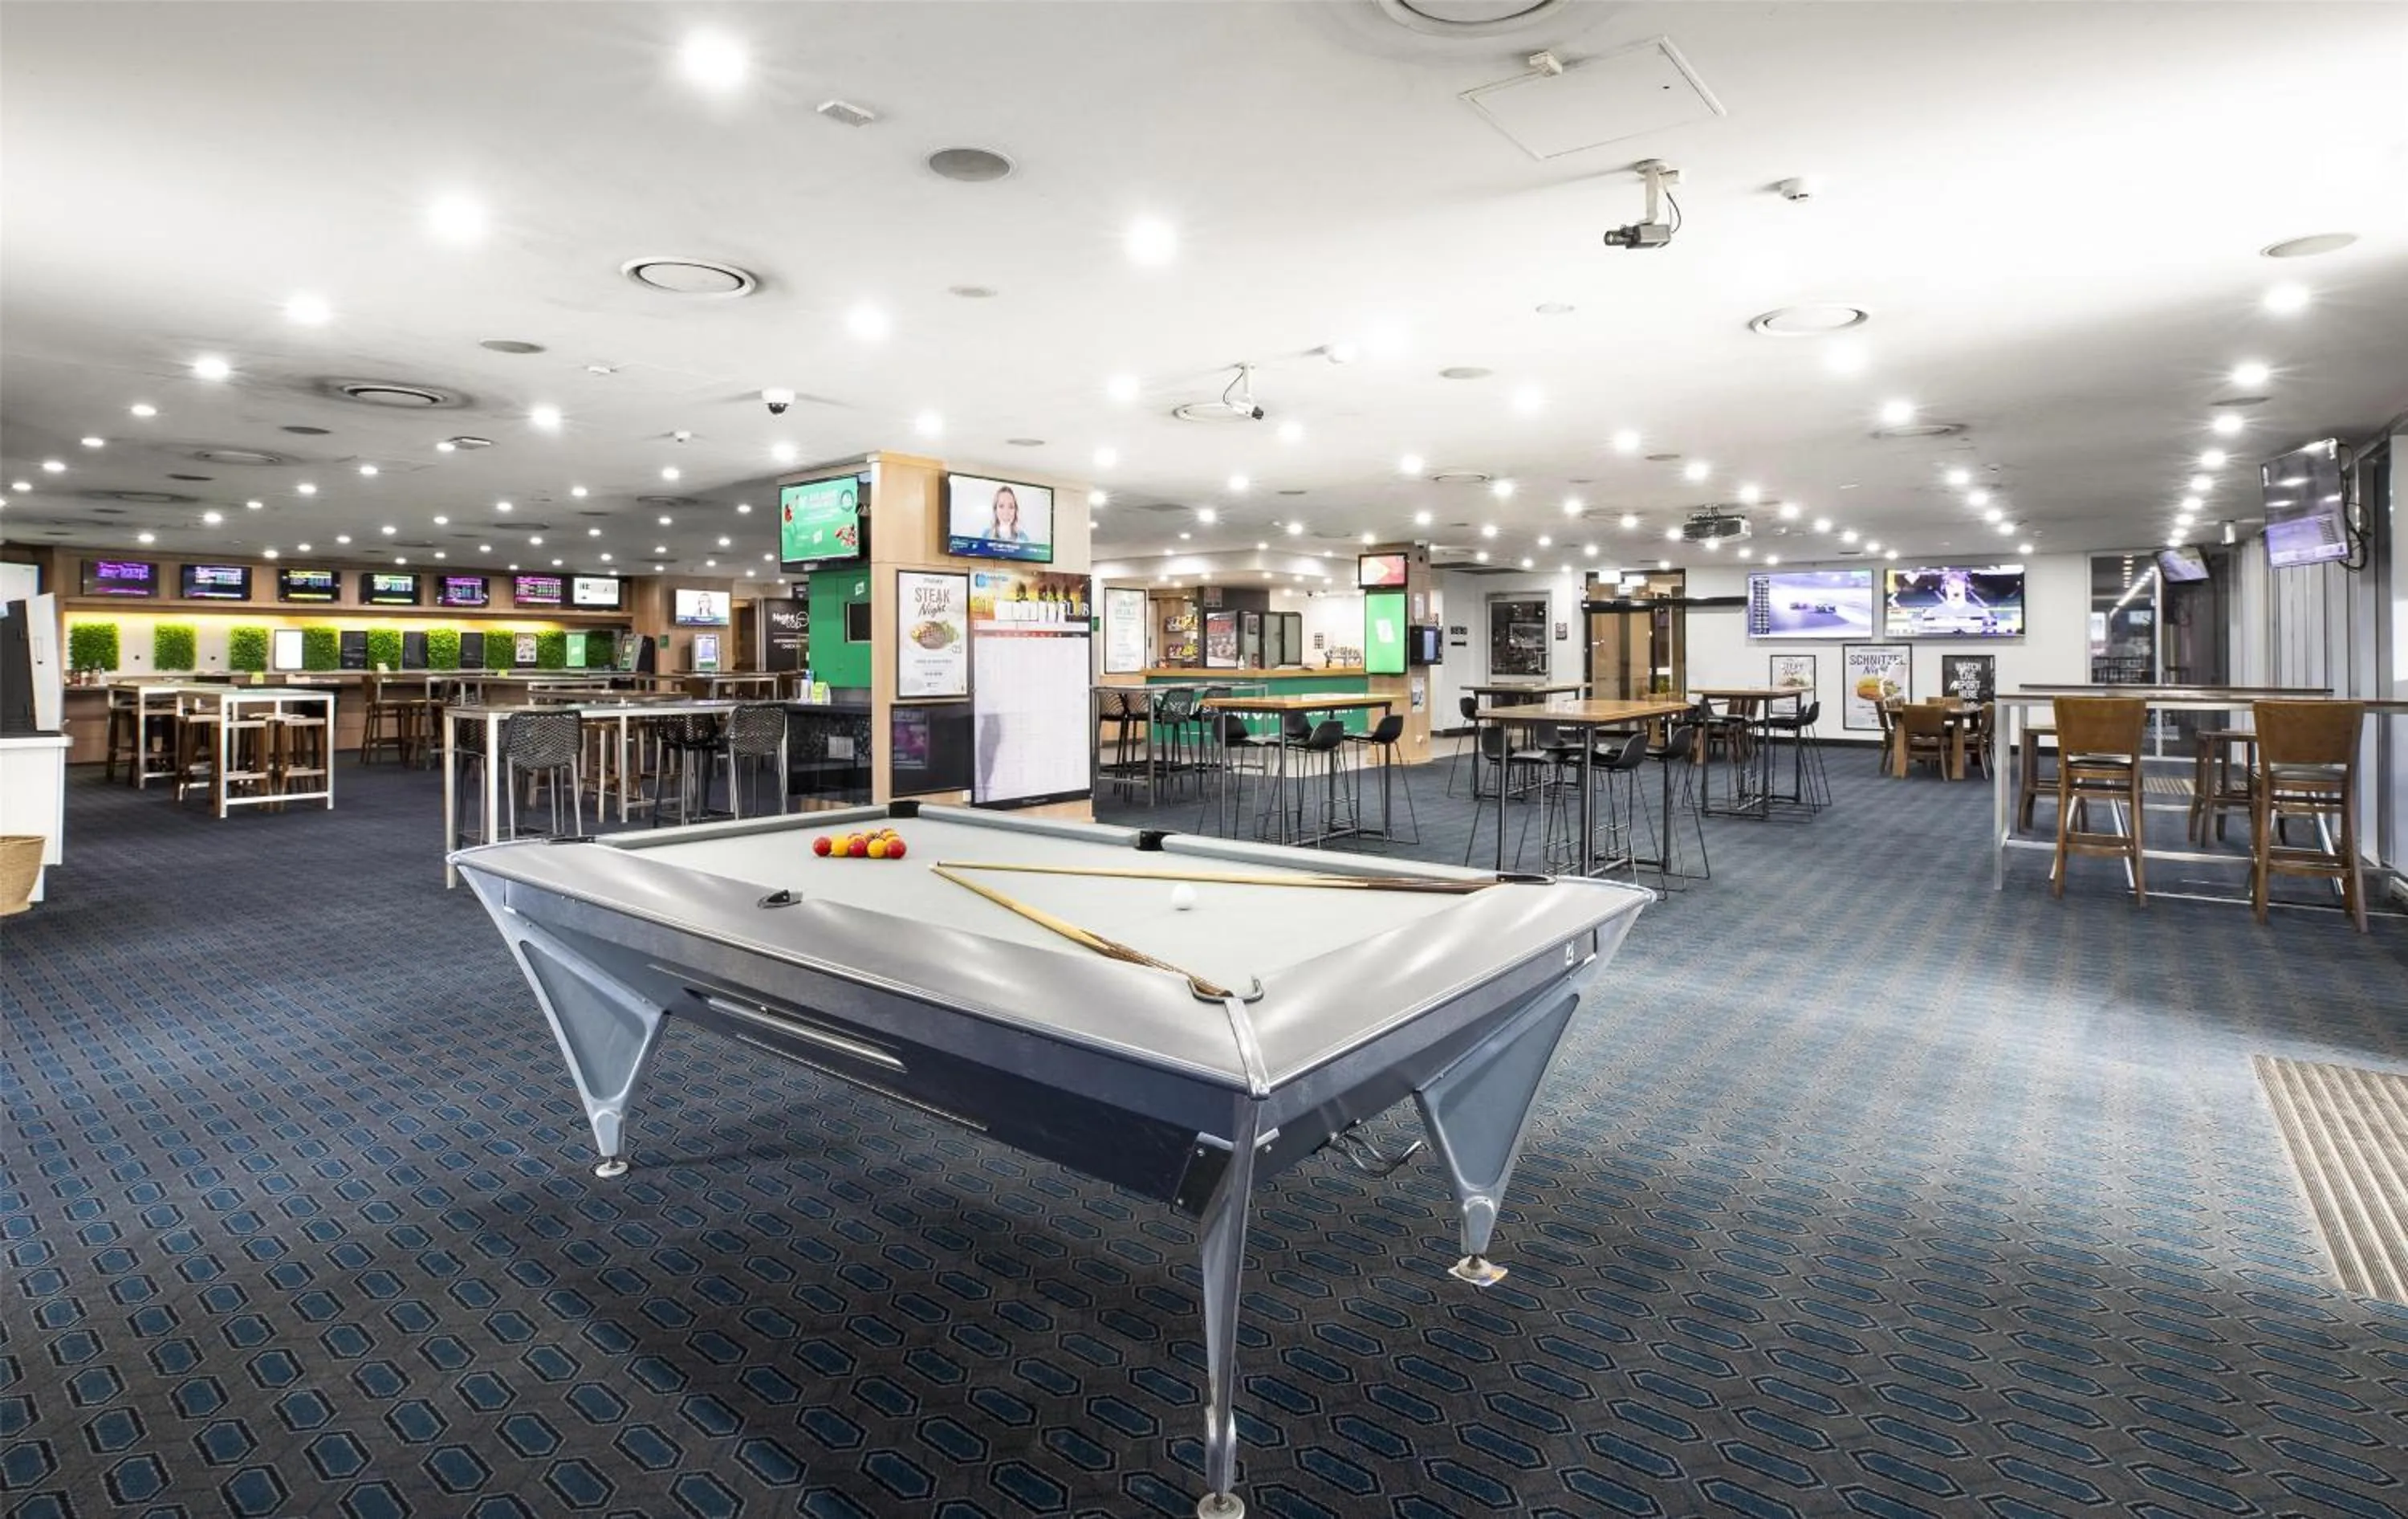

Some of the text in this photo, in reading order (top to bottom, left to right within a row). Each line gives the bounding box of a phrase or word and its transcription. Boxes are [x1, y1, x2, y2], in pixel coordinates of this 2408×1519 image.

[914, 587, 950, 604] STEAK
[918, 602, 946, 617] Night
[1849, 654, 1908, 666] SCHNITZEL
